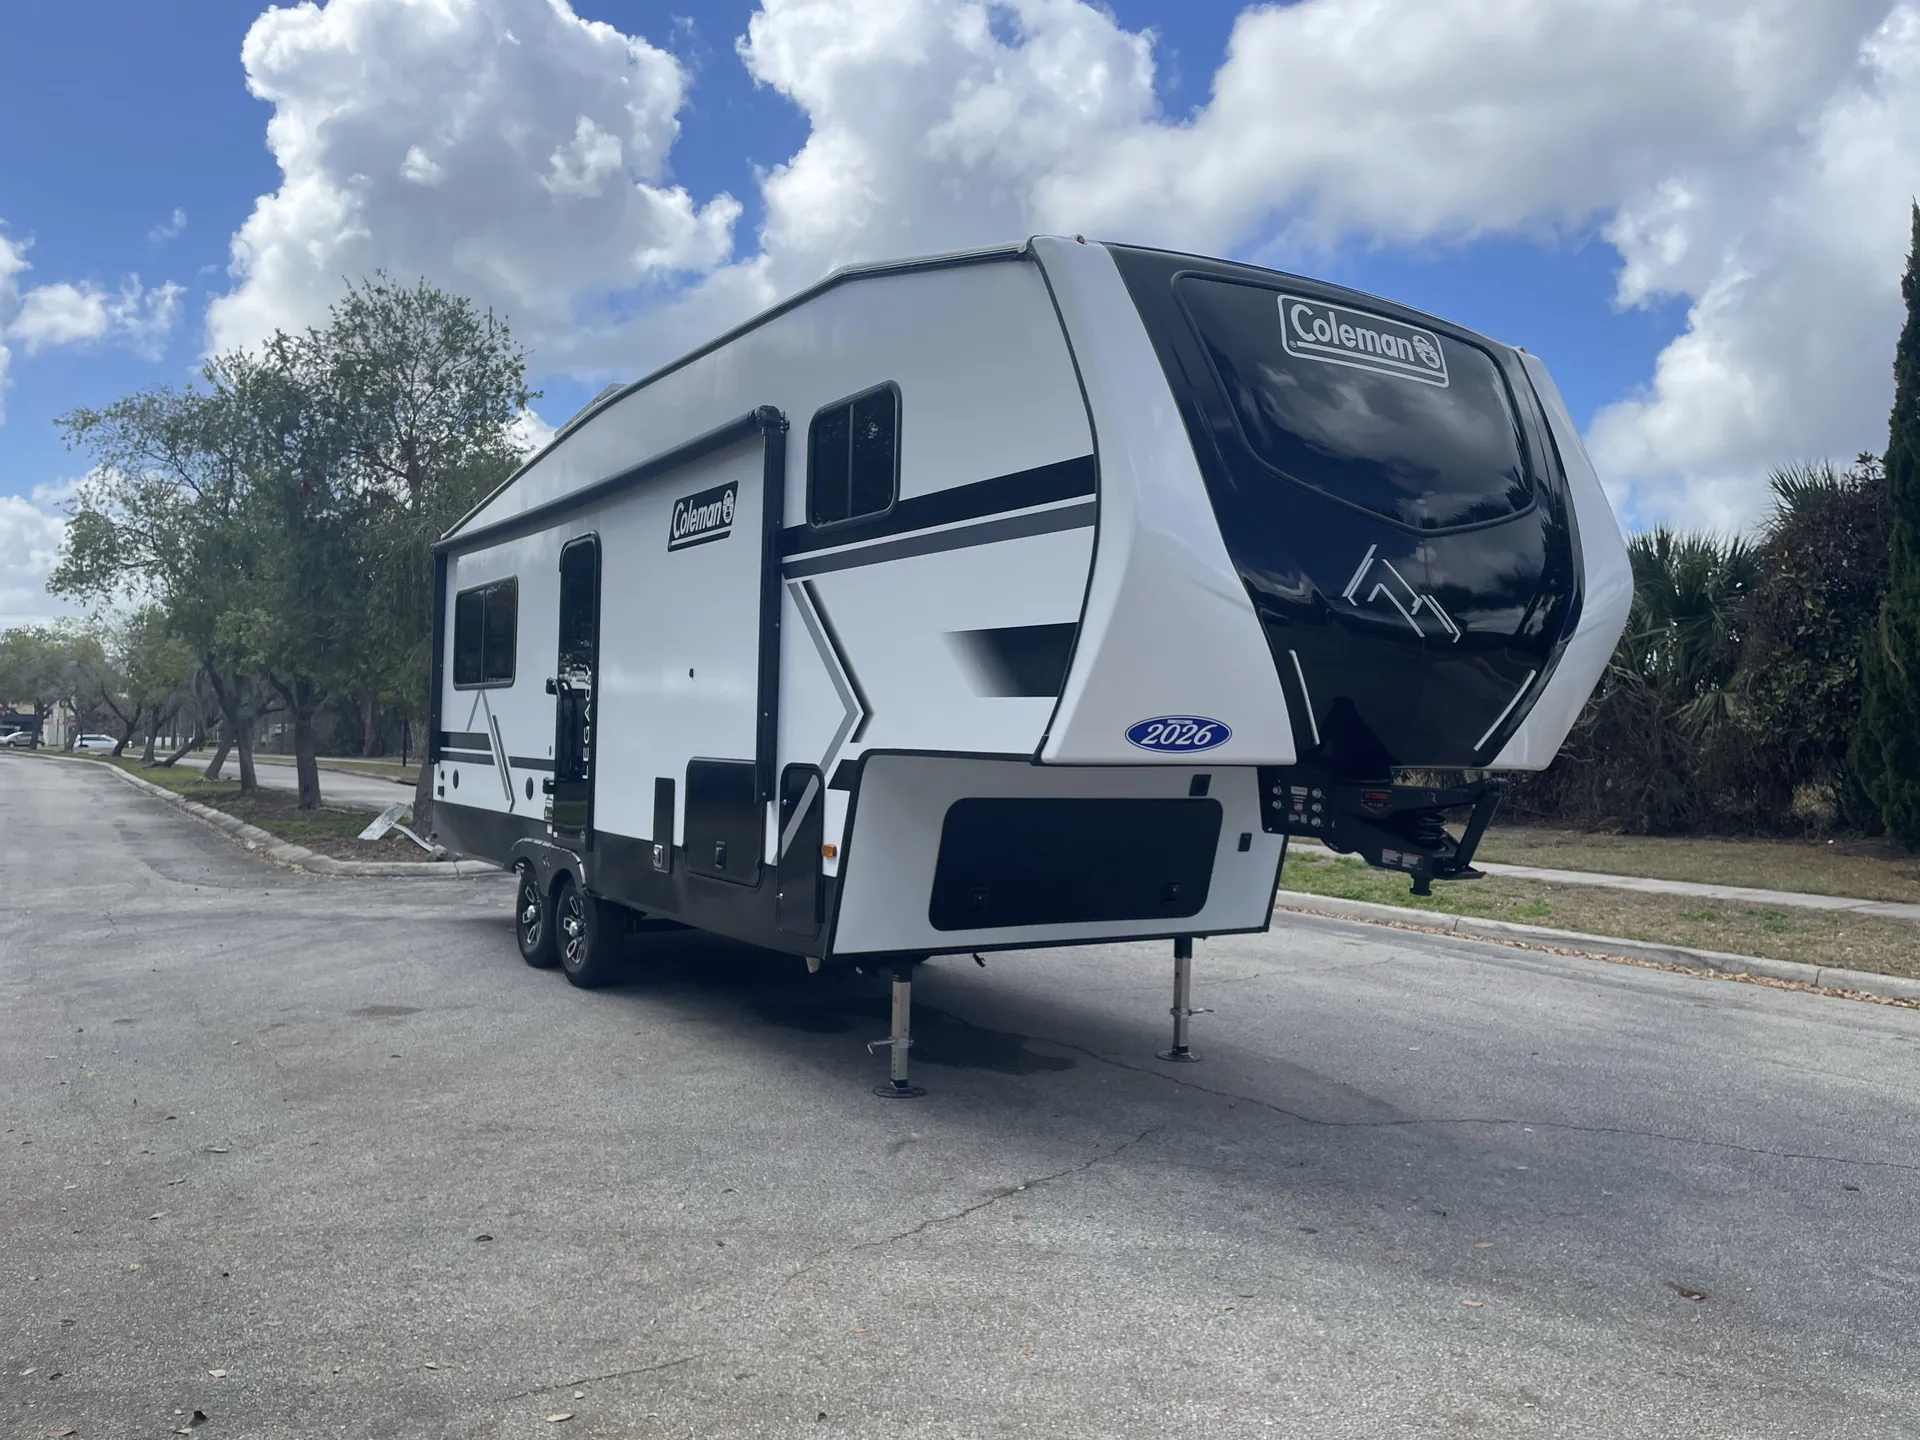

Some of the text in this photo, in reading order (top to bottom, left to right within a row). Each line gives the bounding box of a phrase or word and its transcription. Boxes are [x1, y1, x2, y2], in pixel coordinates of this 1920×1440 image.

[1290, 303, 1415, 362] Coleman
[673, 499, 722, 539] Coleman
[582, 665, 592, 779] LEGACY
[1140, 723, 1218, 746] 2026
